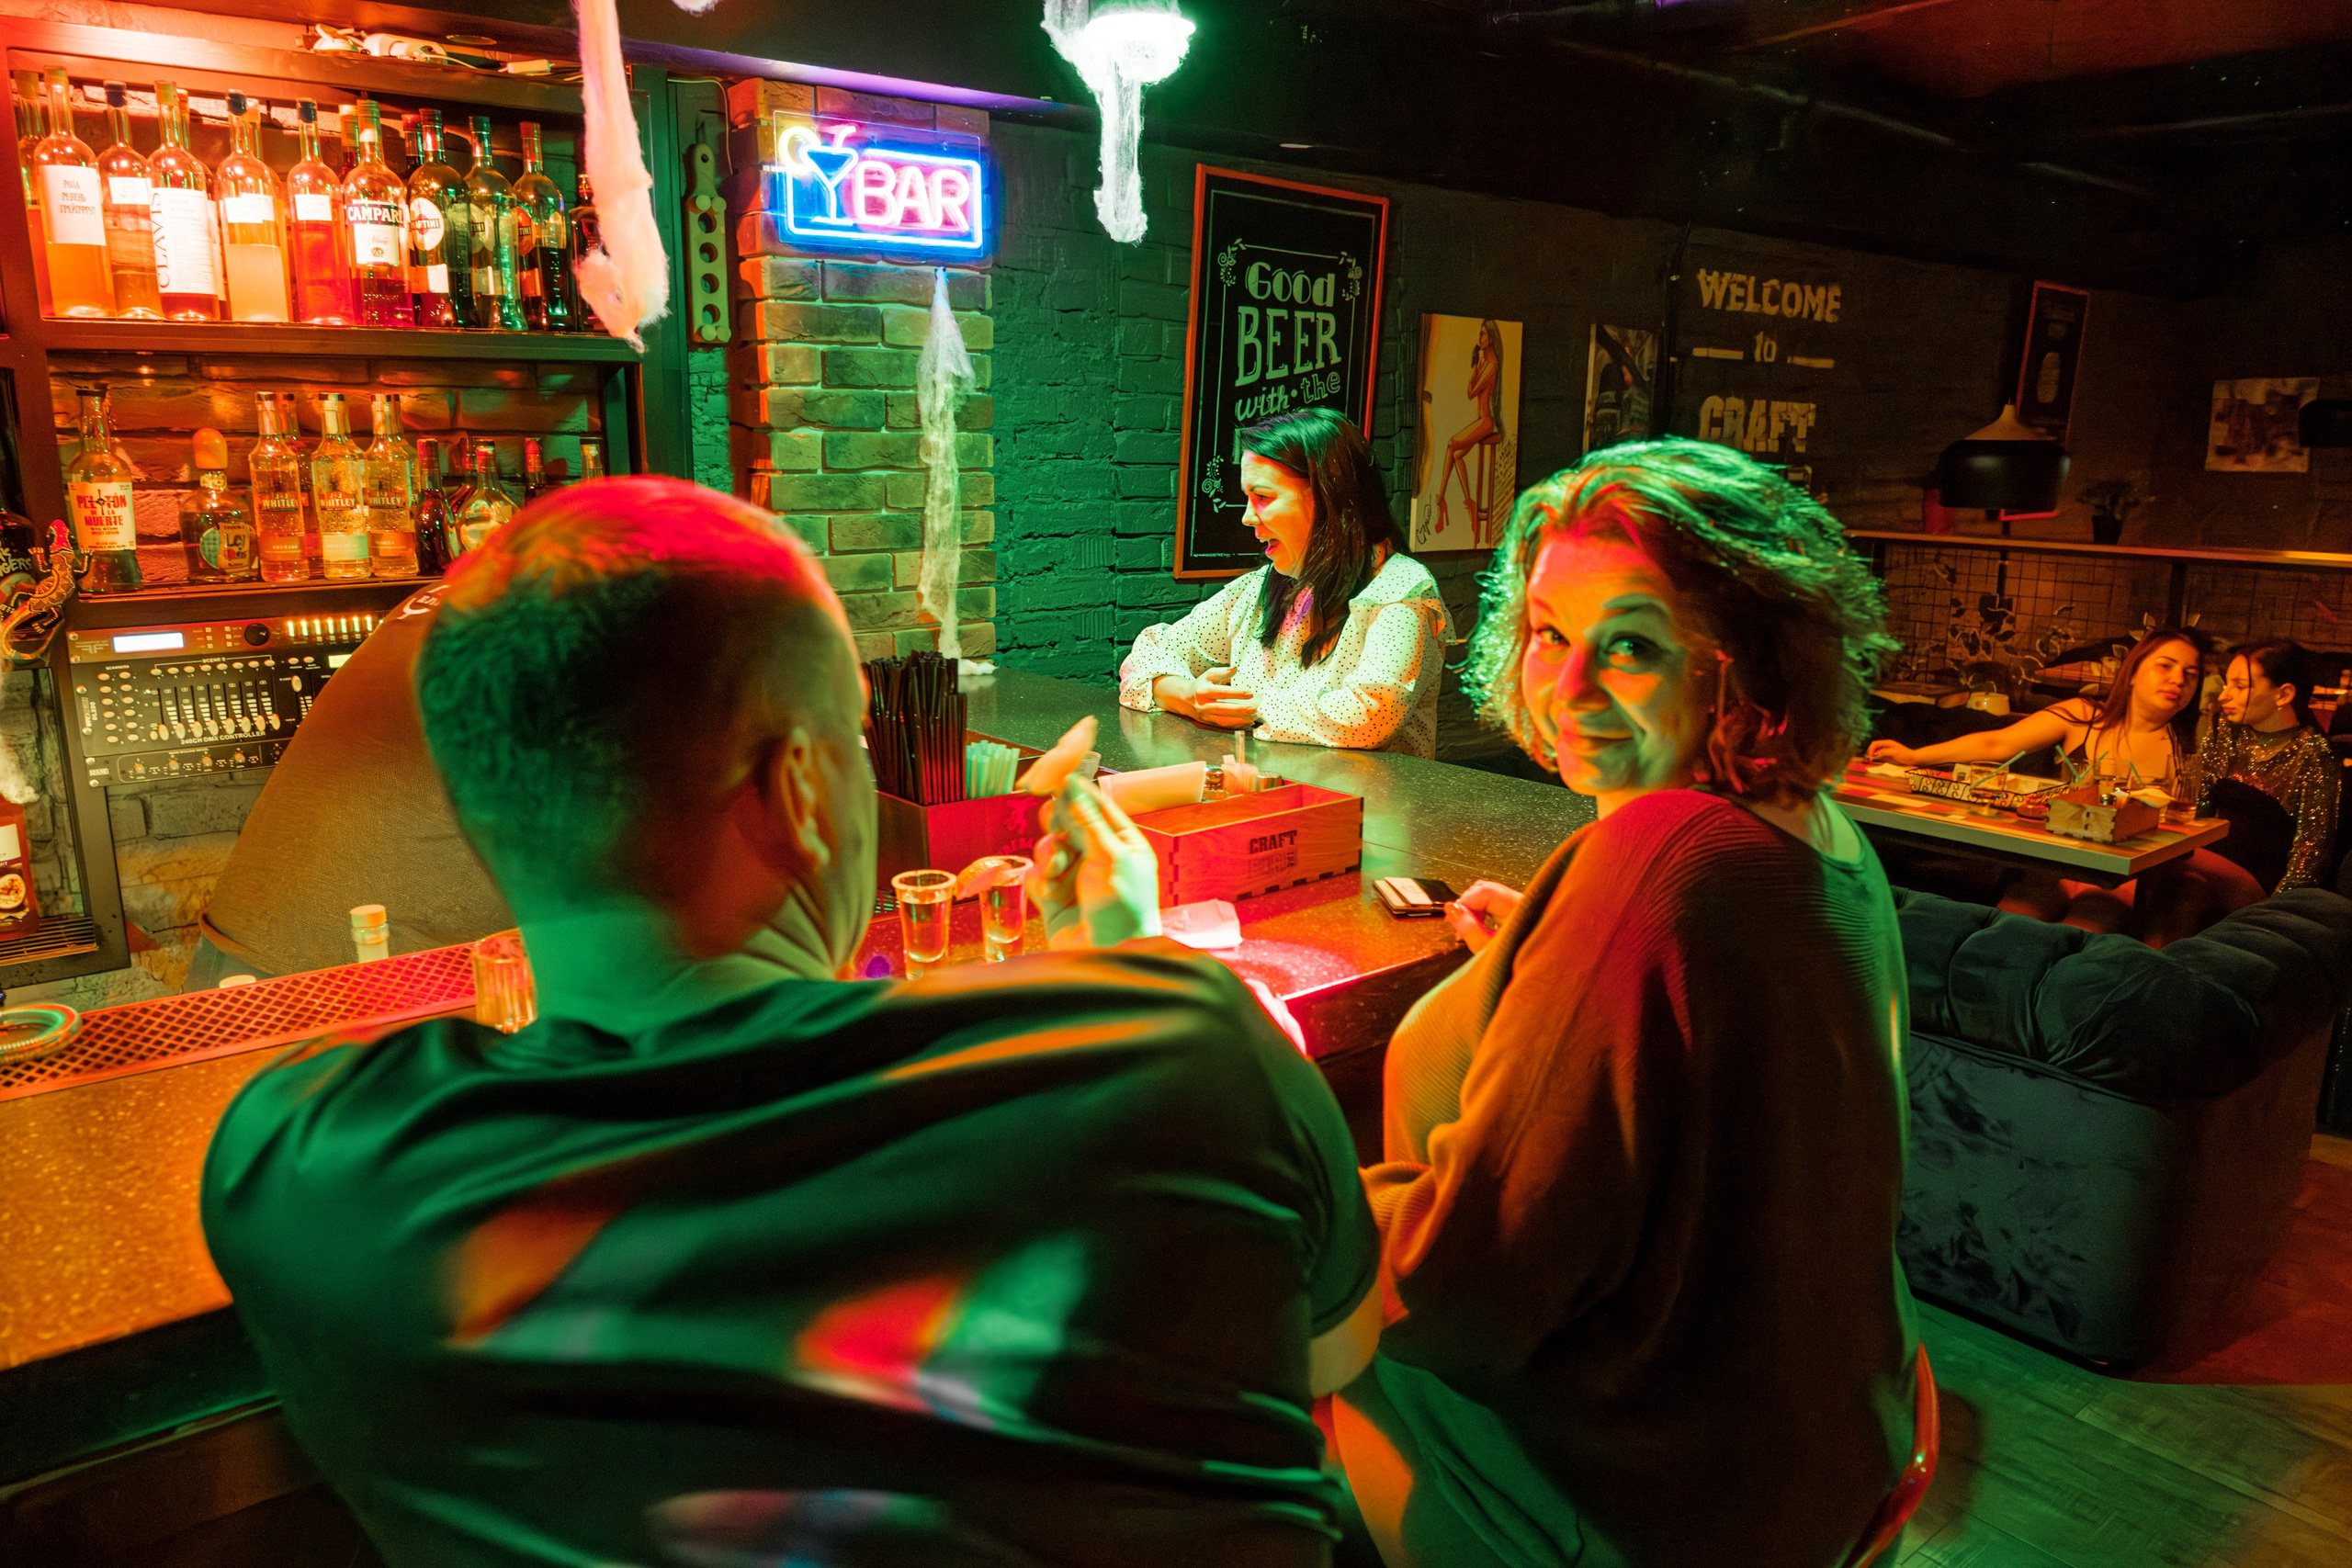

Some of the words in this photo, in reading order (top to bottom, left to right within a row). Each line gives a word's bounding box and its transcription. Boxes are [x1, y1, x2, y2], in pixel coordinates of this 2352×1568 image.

[347, 206, 403, 223] CAMPARI
[856, 160, 970, 232] BAR
[151, 192, 170, 288] CLAVIS
[1245, 261, 1336, 308] Good
[1697, 267, 1842, 322] WELCOME
[1235, 305, 1342, 388] BEER
[1754, 331, 1778, 362] to
[1234, 384, 1290, 422] with
[1300, 371, 1341, 404] the
[1698, 395, 1816, 453] CRAFT
[84, 514, 124, 526] MUERTE
[320, 498, 356, 507] WHITLEY
[220, 730, 266, 741] CONTROLLER
[1250, 829, 1297, 854] CRAFT
